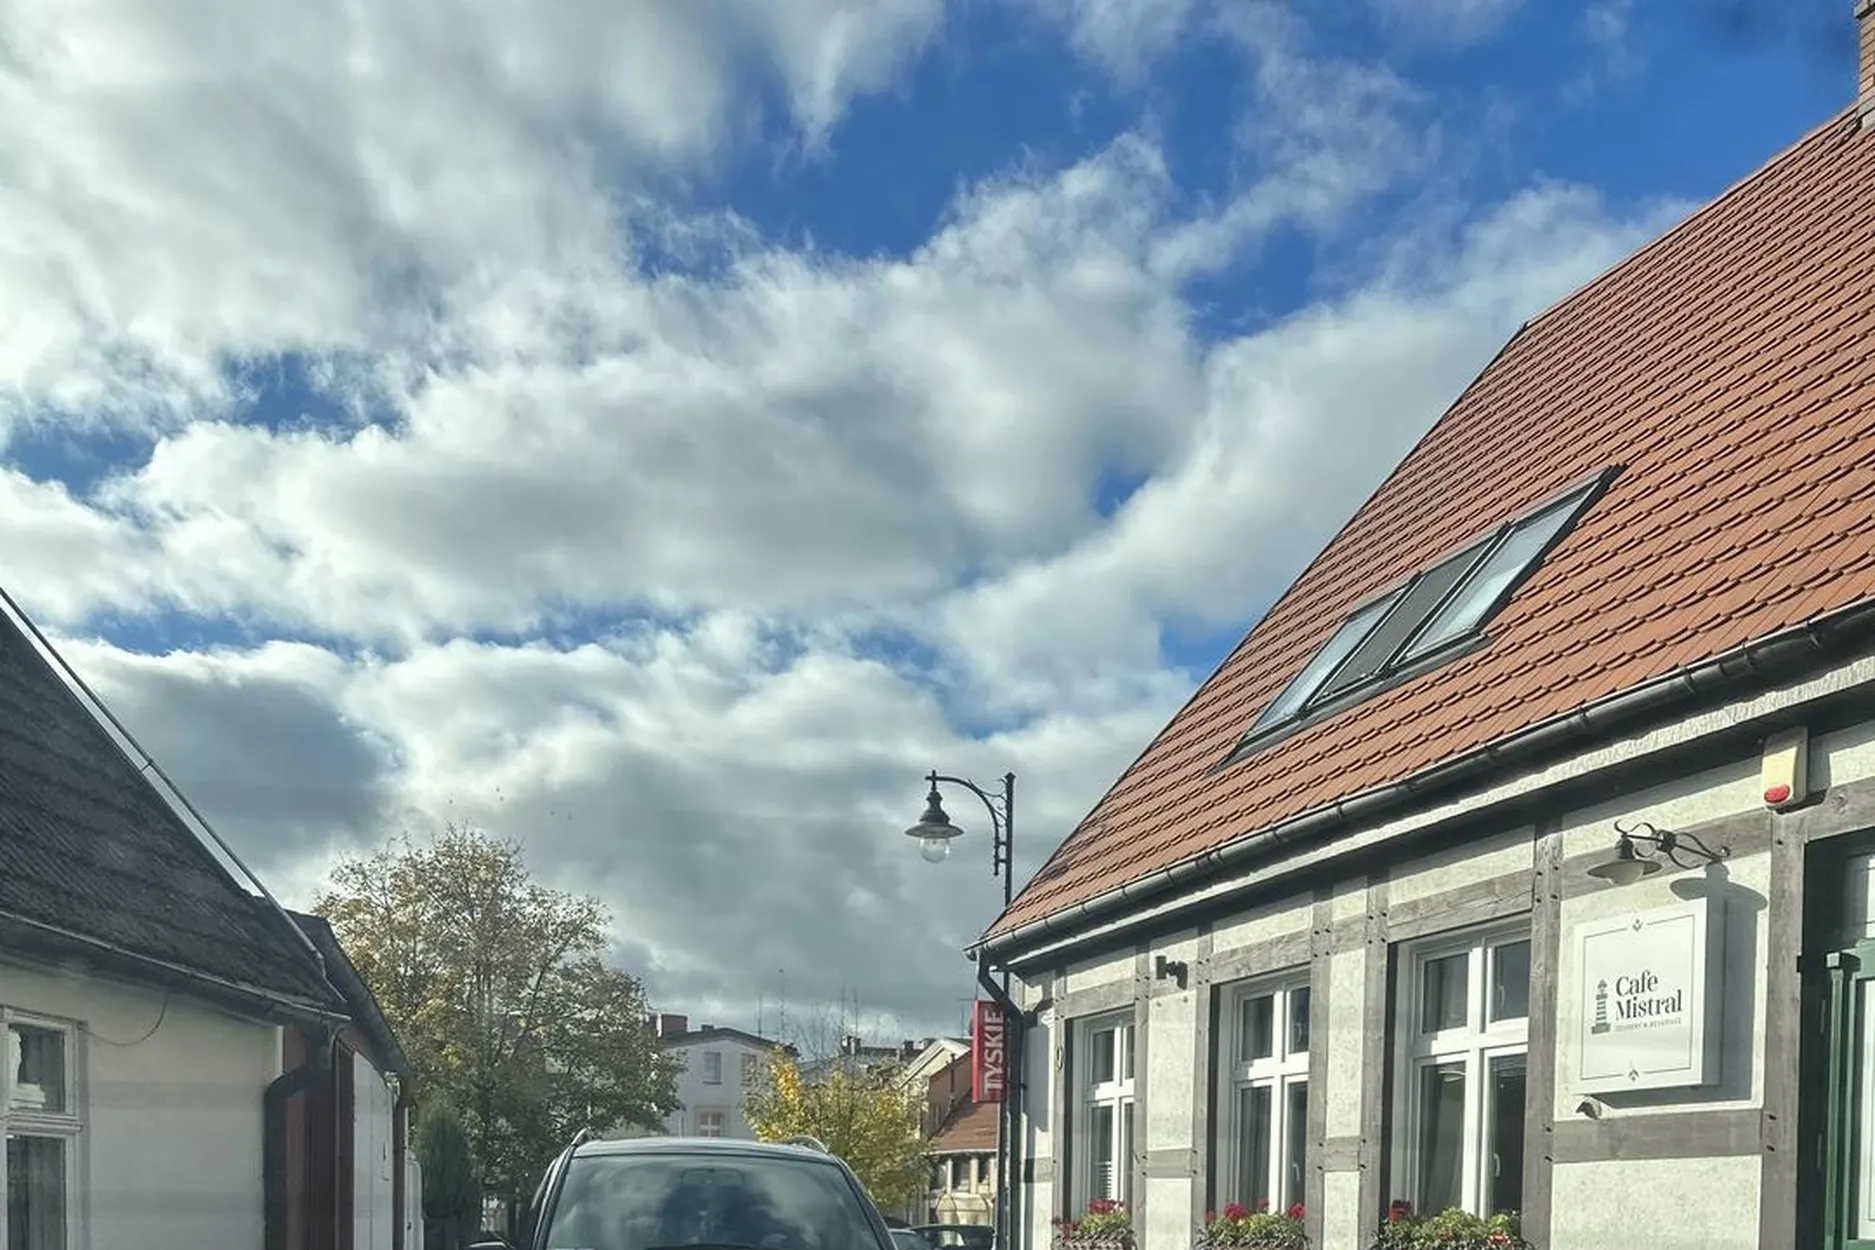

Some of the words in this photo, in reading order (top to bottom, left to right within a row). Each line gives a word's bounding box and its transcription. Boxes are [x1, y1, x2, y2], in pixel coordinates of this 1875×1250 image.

[1615, 969, 1659, 997] Cafe
[1615, 987, 1683, 1021] Mistral
[983, 1009, 1005, 1095] TYSKIE
